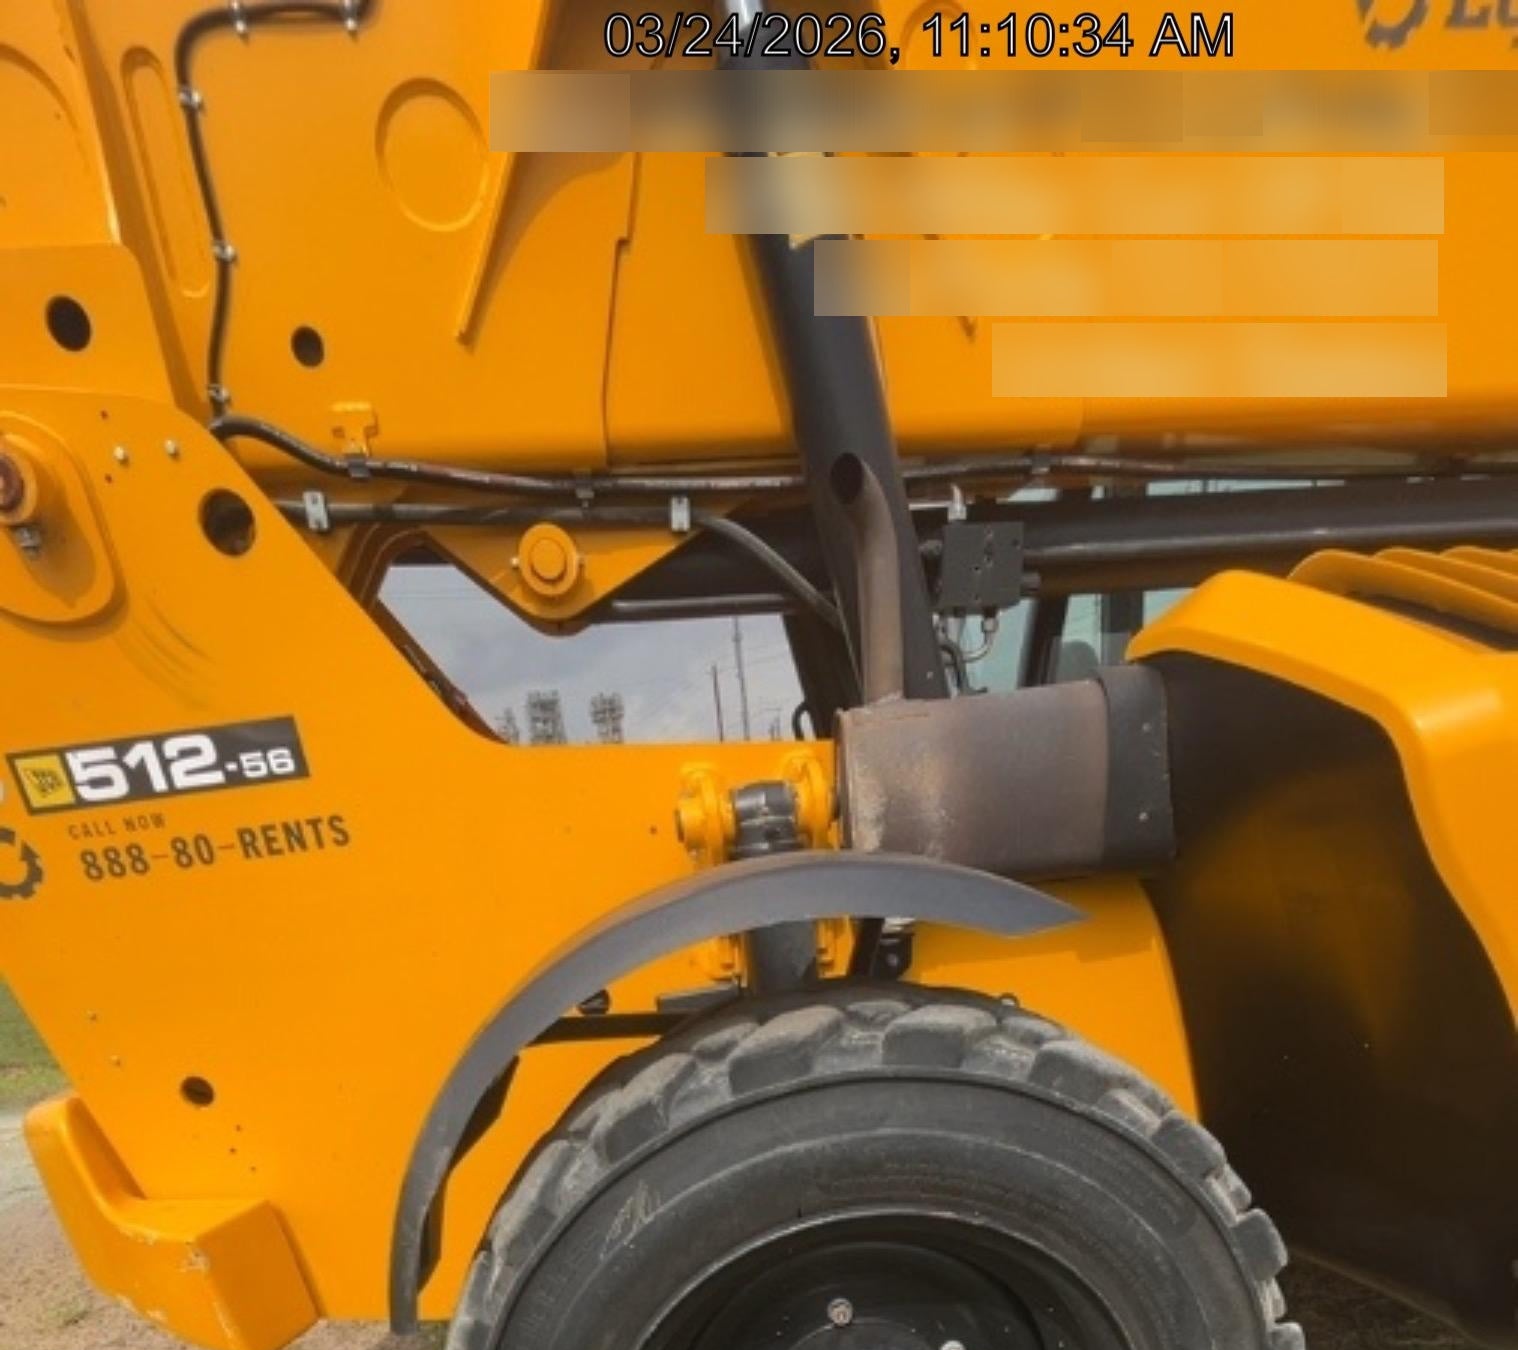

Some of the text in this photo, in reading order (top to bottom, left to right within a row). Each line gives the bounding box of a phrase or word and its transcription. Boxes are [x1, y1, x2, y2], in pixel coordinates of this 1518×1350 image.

[64, 733, 296, 802] 512-56
[68, 812, 166, 840] CALL NOW
[80, 815, 351, 882] 888-80-RENTS
